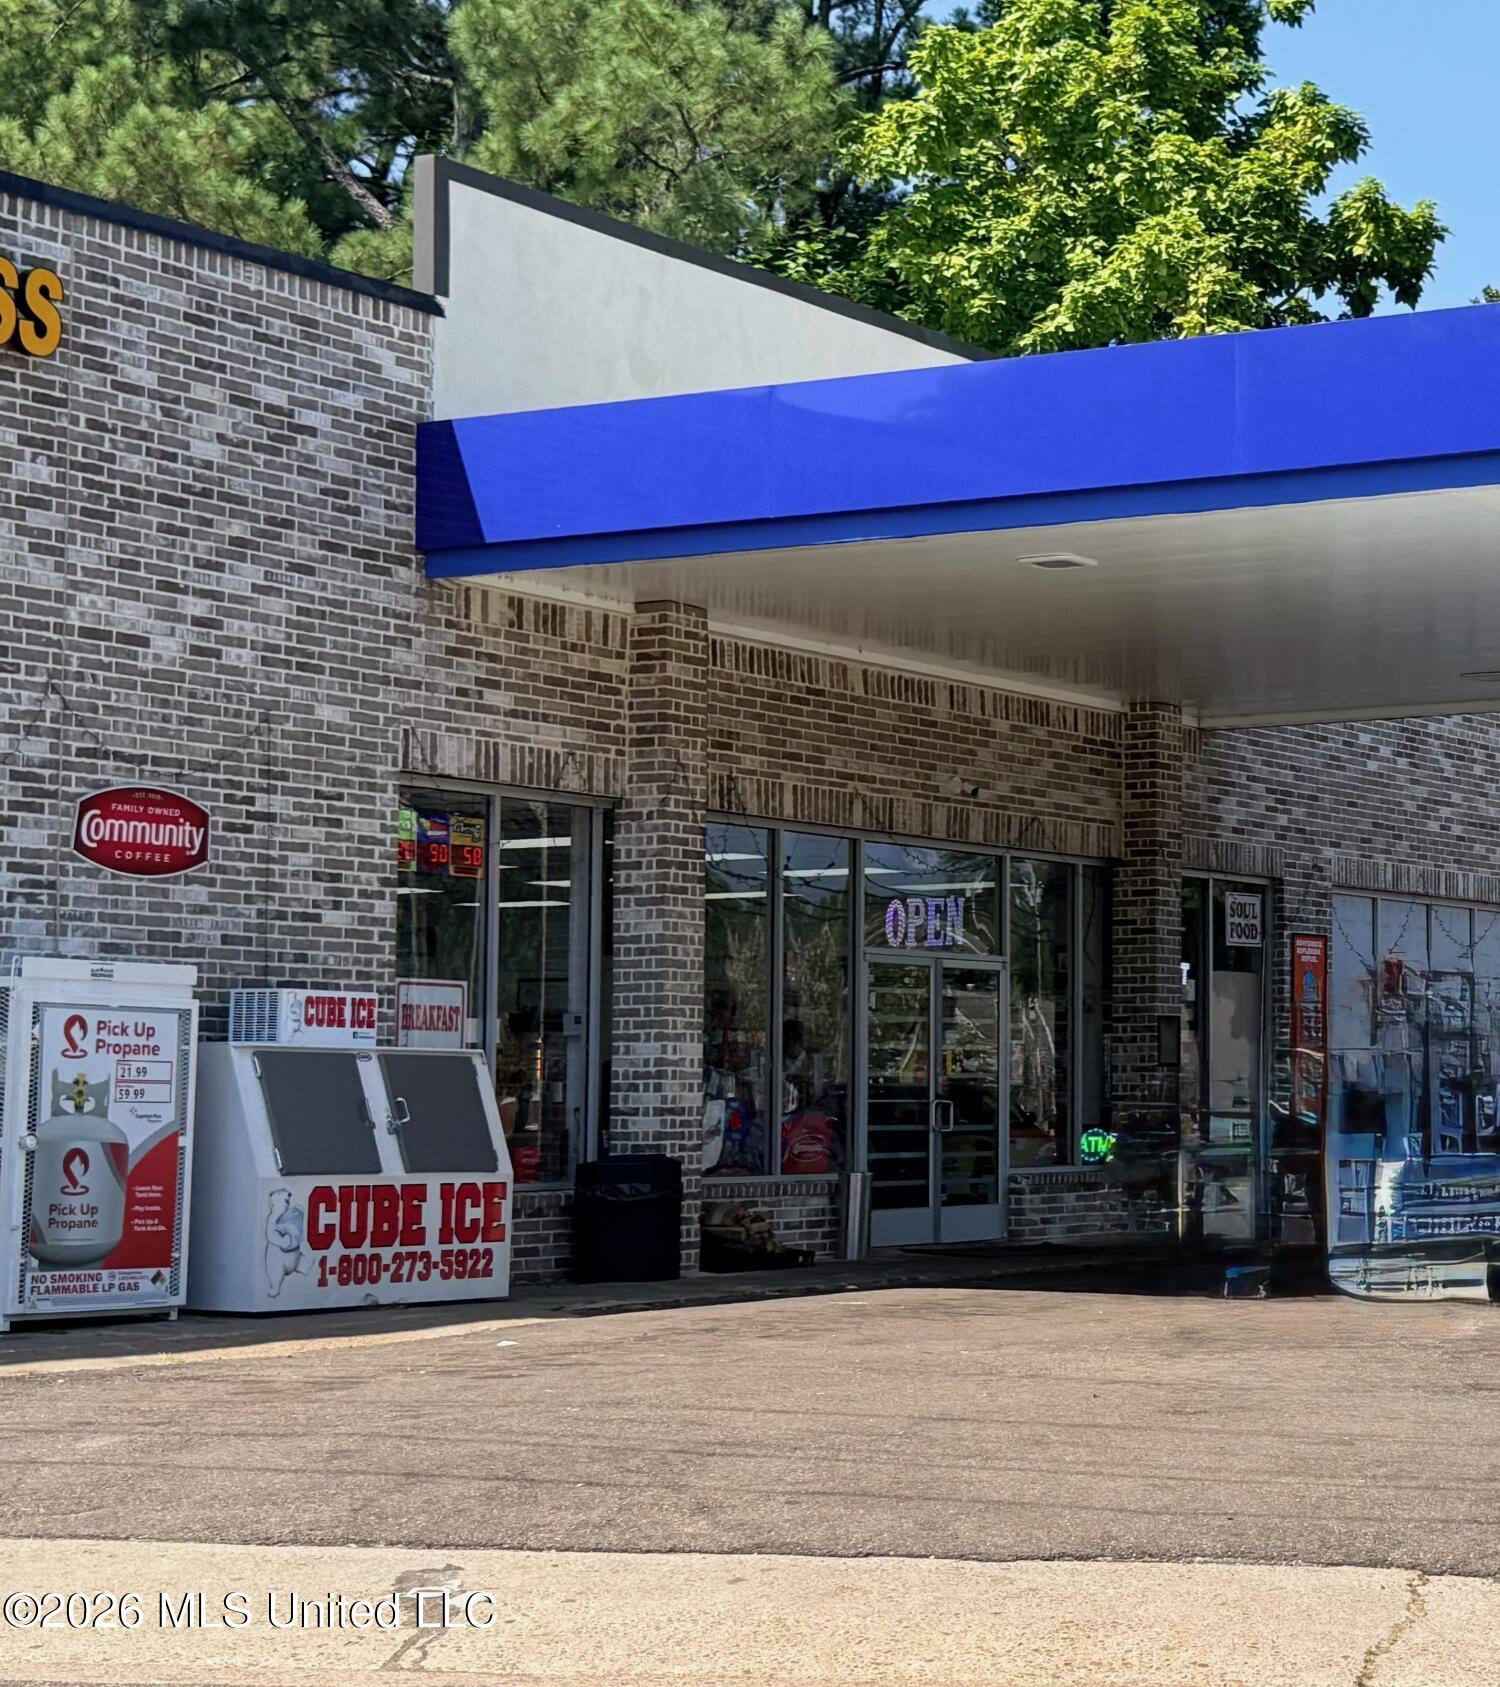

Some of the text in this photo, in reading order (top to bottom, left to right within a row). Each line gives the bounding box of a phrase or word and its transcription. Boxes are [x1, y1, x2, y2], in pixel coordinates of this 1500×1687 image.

[111, 803, 181, 817] FAMILY OWNED
[81, 809, 205, 856] Community
[114, 850, 172, 863] COFFEE
[1229, 901, 1258, 919] SOUL
[885, 895, 966, 948] OPEN
[1229, 921, 1259, 940] FOOD
[304, 995, 377, 1029] CUBE ICE
[401, 1003, 461, 1032] BREAKFAST
[96, 1020, 156, 1040] Pick Up
[95, 1038, 161, 1058] Propane
[118, 1088, 145, 1100] 59.99
[48, 1203, 98, 1217] Pick Up
[307, 1182, 508, 1250] CUBE ICE
[48, 1218, 98, 1231] Propane
[317, 1247, 494, 1288] 1-800-273-5922
[30, 1282, 140, 1295] FLAMMABLE LP GAS
[31, 1273, 103, 1285] NO SMOKING
